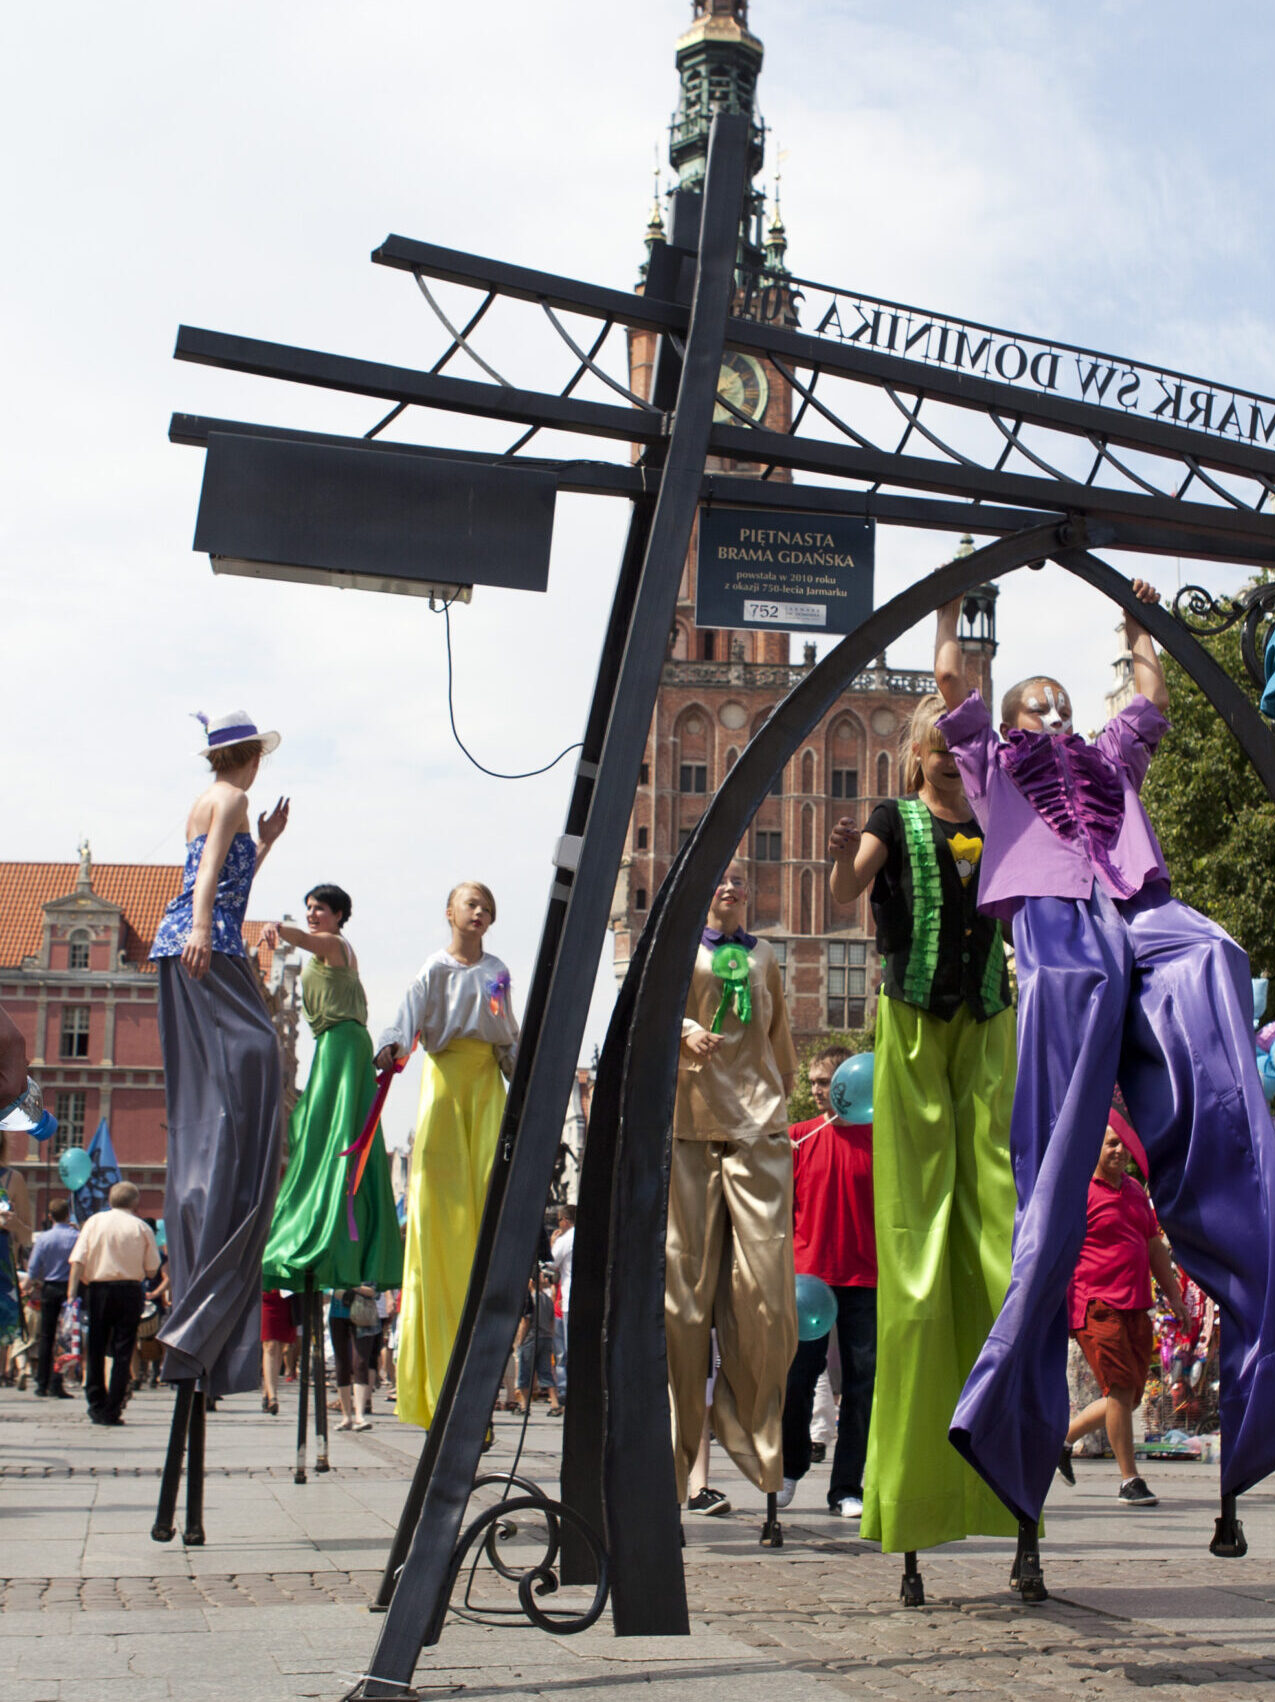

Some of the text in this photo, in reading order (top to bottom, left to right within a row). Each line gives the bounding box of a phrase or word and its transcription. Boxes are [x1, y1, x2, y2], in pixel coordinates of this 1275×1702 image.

[740, 528, 835, 548] PIĘTNASTA
[718, 546, 855, 567] BRAMA GDAŃSKA
[736, 571, 777, 582] powstała
[790, 573, 813, 583] 2010
[815, 575, 836, 585] roku
[732, 582, 760, 593] okazji
[761, 583, 804, 595] 750-lecia
[806, 586, 848, 598] Jarmarku
[749, 604, 779, 618] 752
